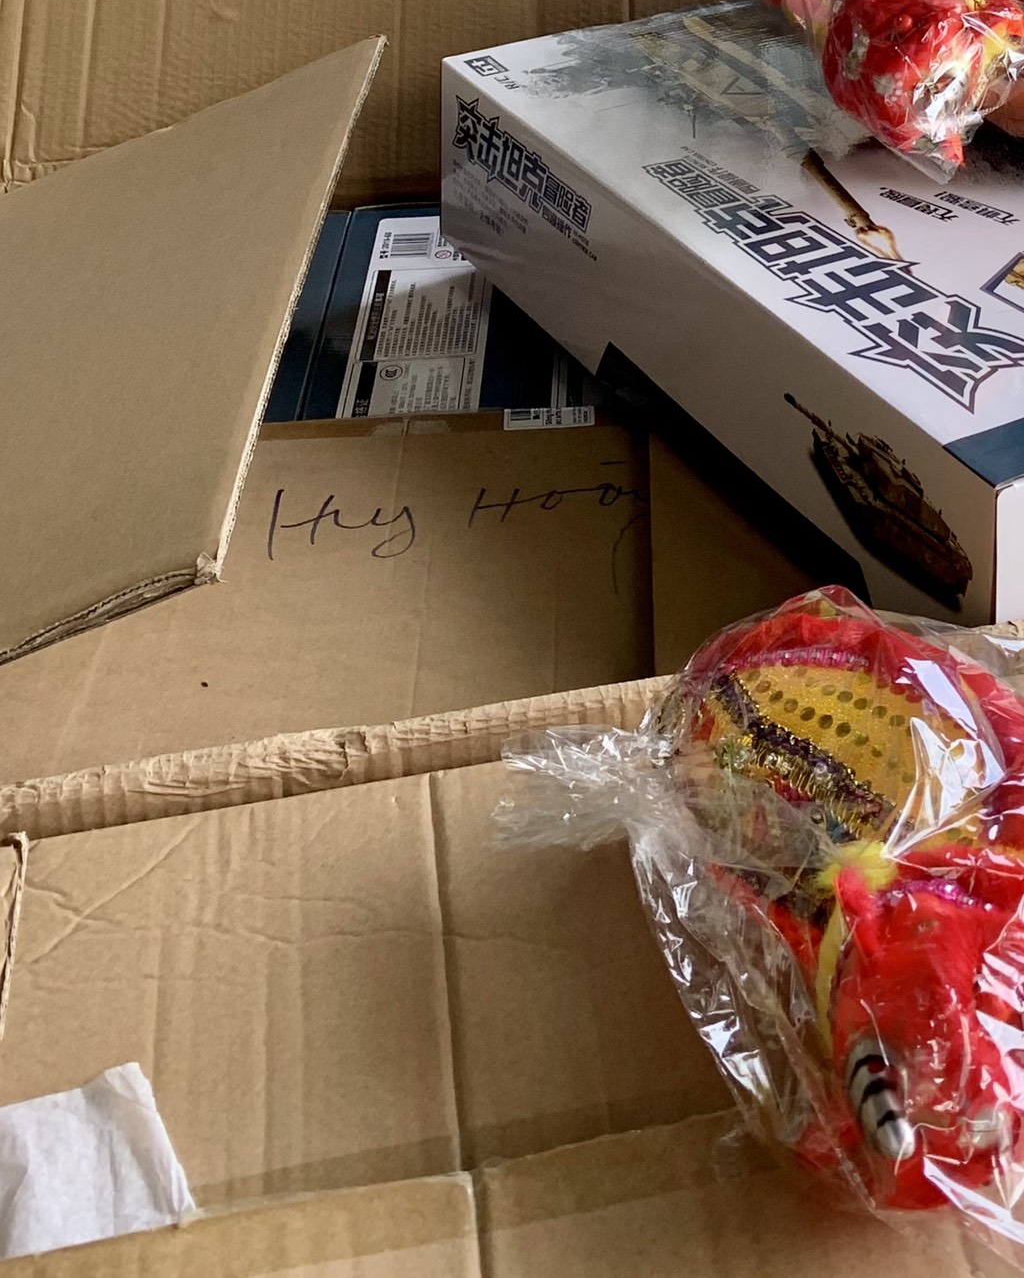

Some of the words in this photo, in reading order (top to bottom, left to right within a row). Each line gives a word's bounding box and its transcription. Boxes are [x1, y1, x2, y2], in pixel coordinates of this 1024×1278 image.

[452, 95, 592, 233] 突击坦克冒险者
